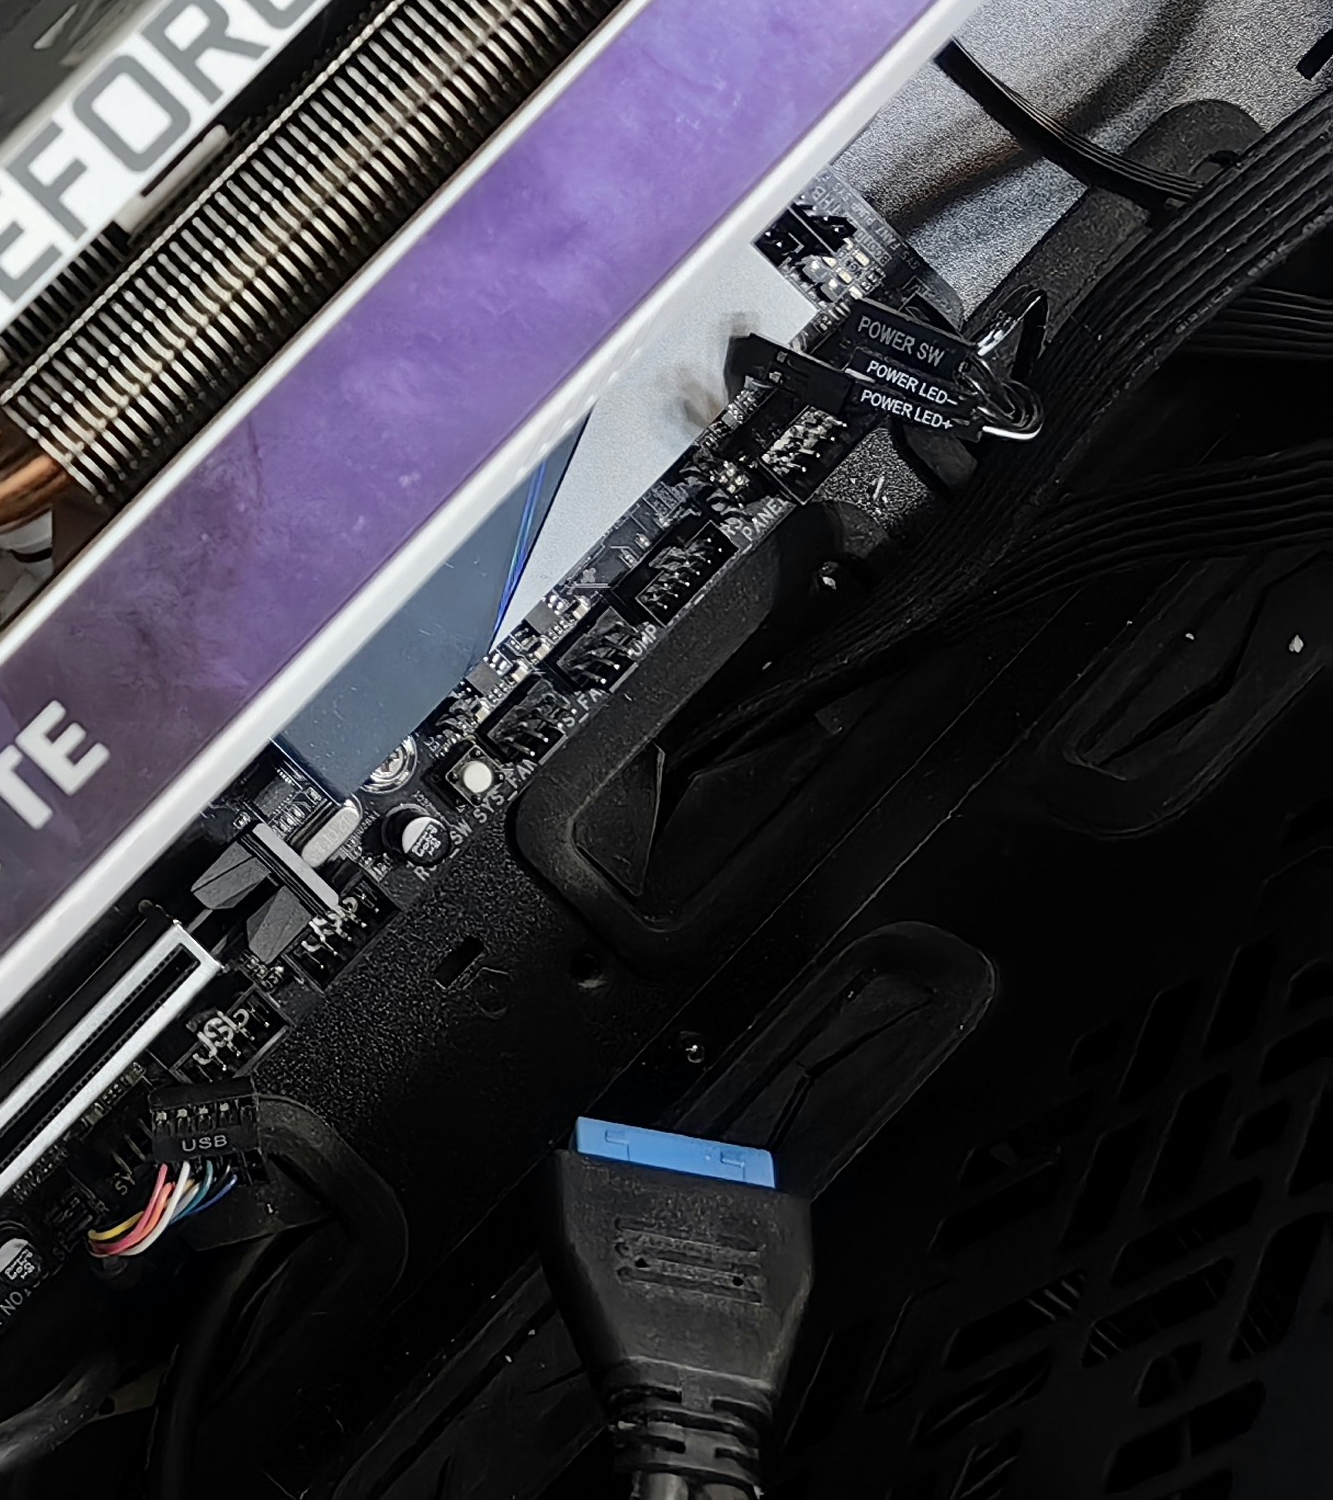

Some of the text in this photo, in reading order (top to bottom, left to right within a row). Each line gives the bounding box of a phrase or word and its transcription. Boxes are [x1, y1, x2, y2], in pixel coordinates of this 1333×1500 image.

[857, 315, 944, 368] POWER SW
[867, 359, 917, 392] POWER
[860, 388, 954, 431] POWER LED+
[181, 1134, 228, 1152] USB
